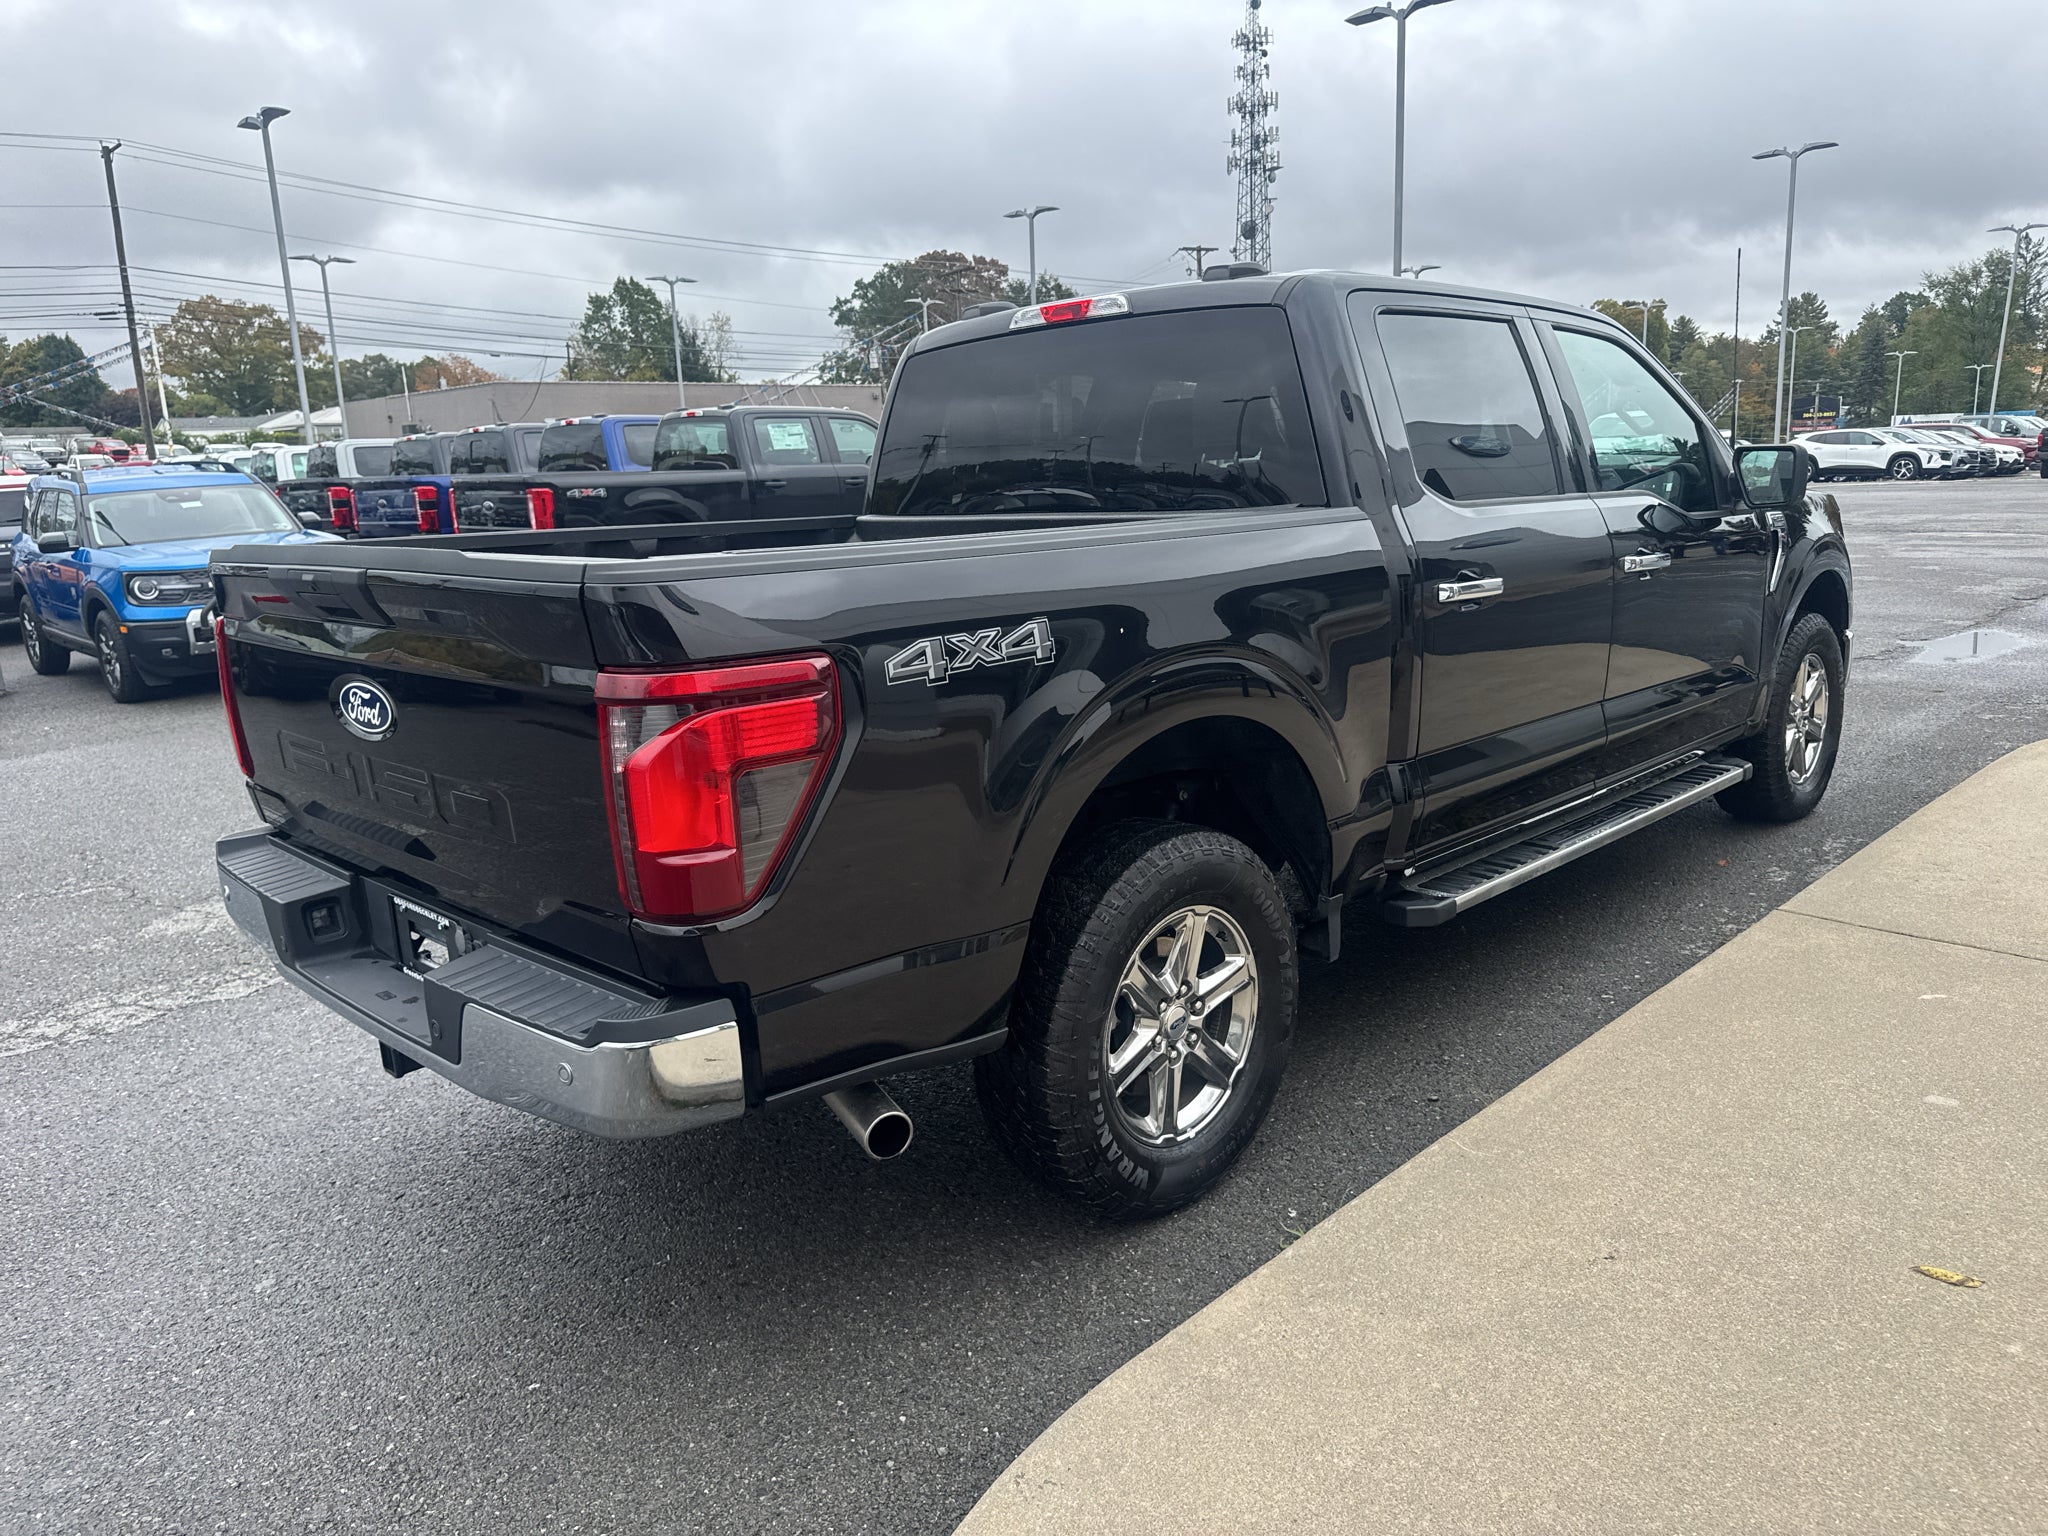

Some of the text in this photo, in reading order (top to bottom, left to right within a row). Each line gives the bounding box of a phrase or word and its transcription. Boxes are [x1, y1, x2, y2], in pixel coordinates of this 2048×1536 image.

[349, 688, 381, 726] Ford
[277, 729, 517, 844] F-150
[1087, 1035, 1150, 1192] WRANGLER
